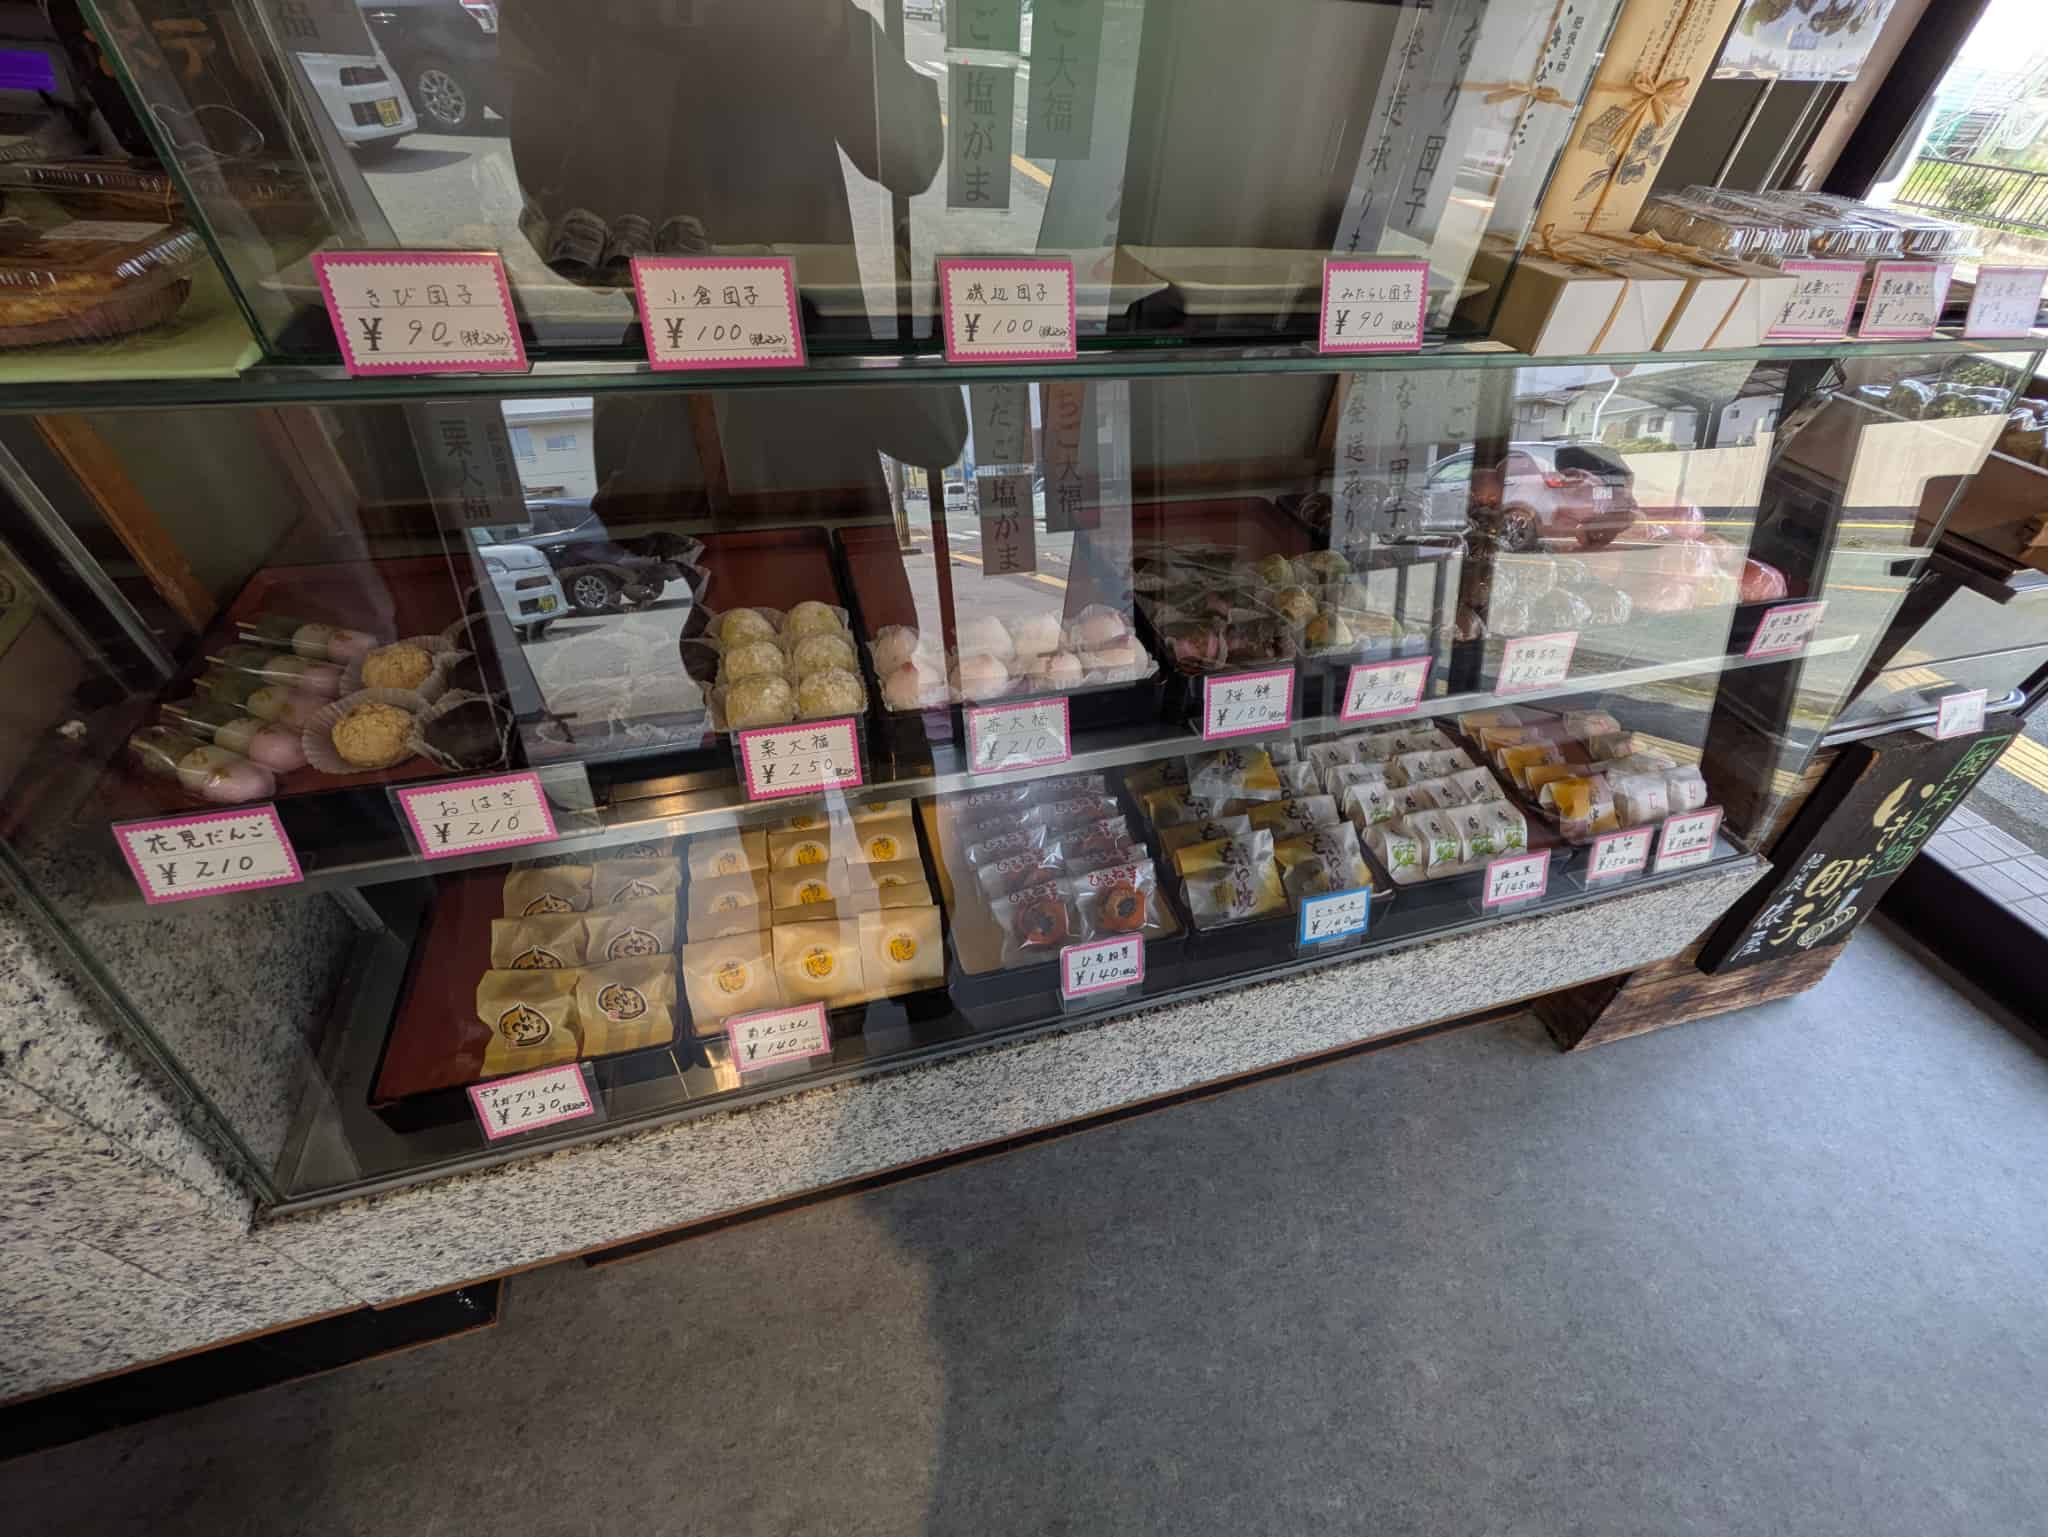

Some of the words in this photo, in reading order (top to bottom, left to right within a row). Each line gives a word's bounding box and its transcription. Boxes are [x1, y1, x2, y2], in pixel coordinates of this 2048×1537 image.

[366, 285, 473, 308] きび団子
[666, 286, 759, 307] 小倉団子
[760, 734, 830, 759] 栗大福
[438, 789, 516, 817] おはぎ
[144, 822, 264, 854] 花見だんご
[1769, 858, 1855, 946] 団子
